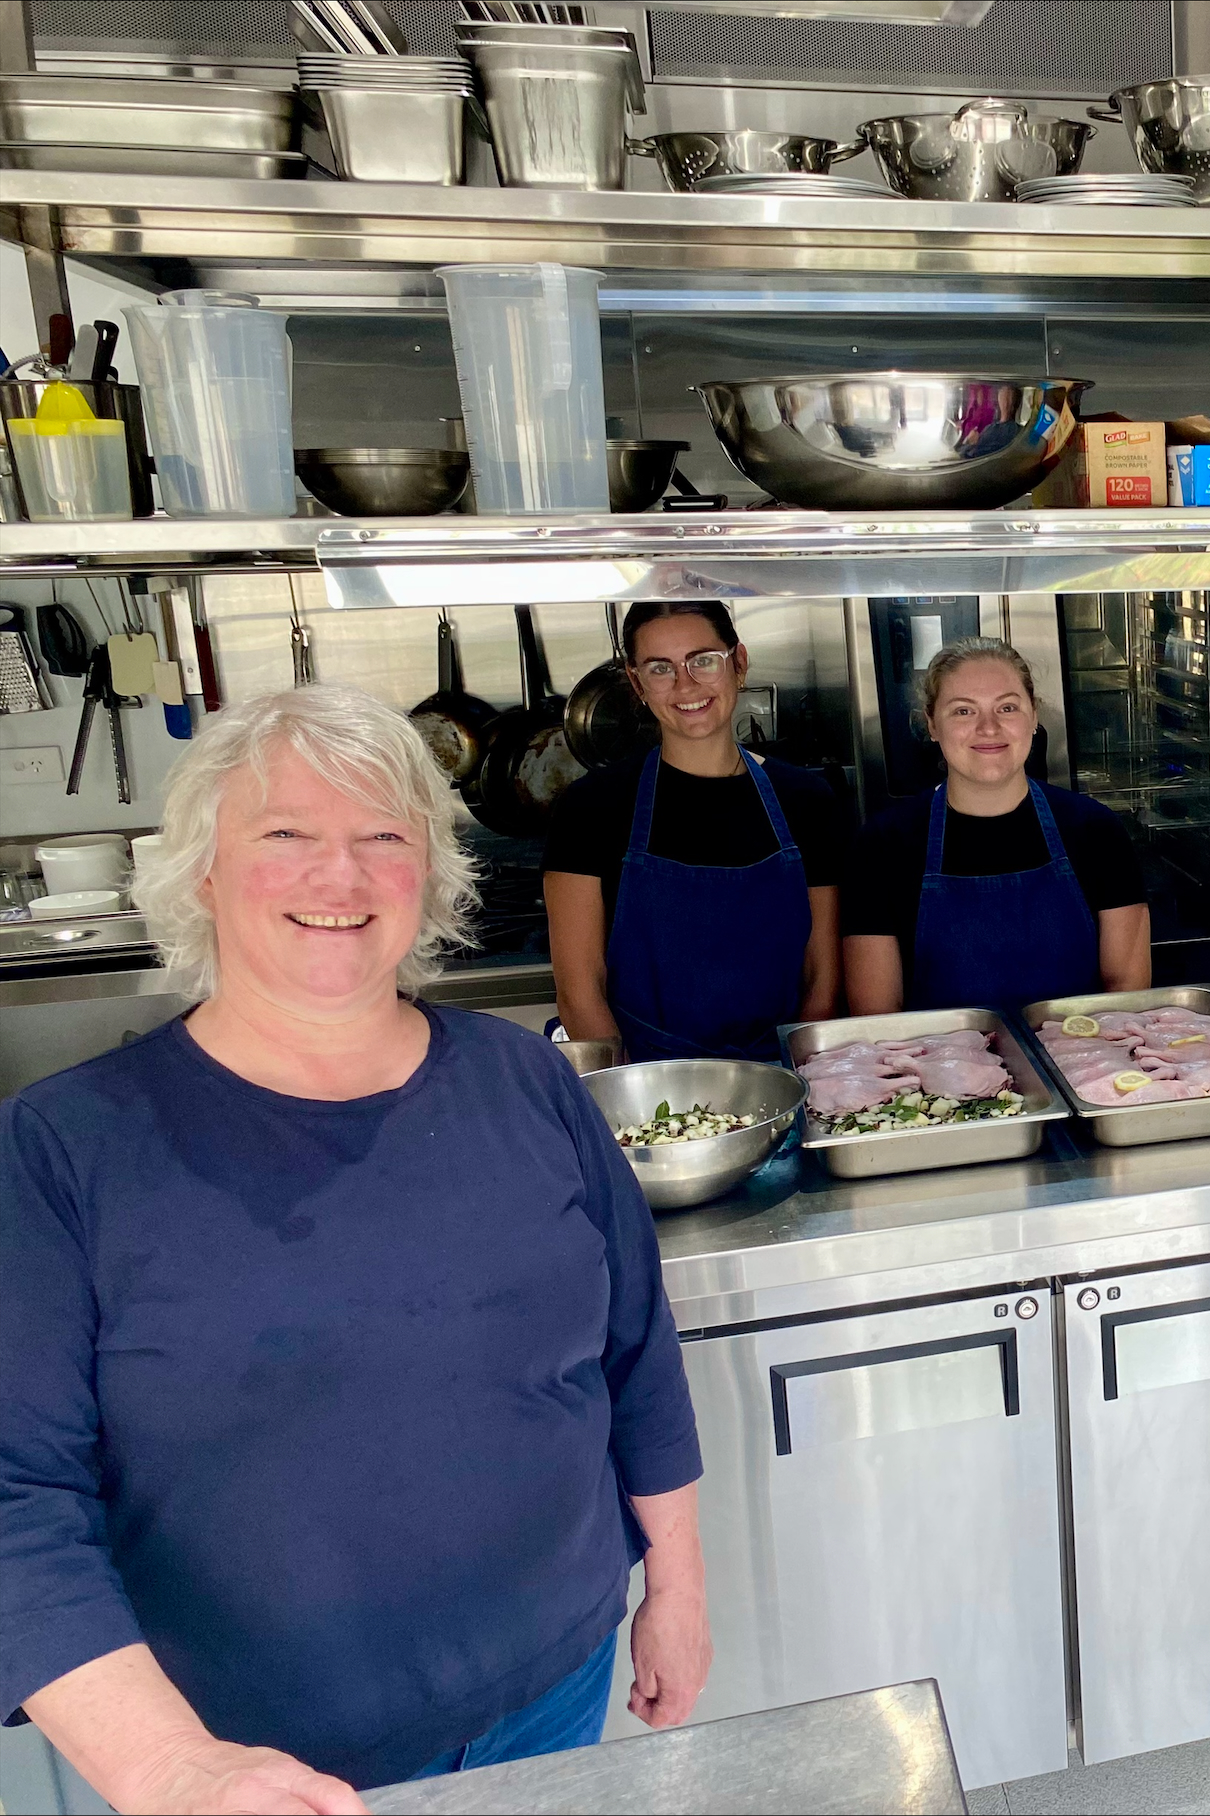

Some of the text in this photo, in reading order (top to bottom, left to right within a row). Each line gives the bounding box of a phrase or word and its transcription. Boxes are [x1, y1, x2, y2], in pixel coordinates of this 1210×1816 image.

[1105, 432, 1126, 442] GLAD
[1109, 479, 1134, 492] 120
[1110, 1290, 1118, 1298] R
[997, 1307, 1006, 1316] R
